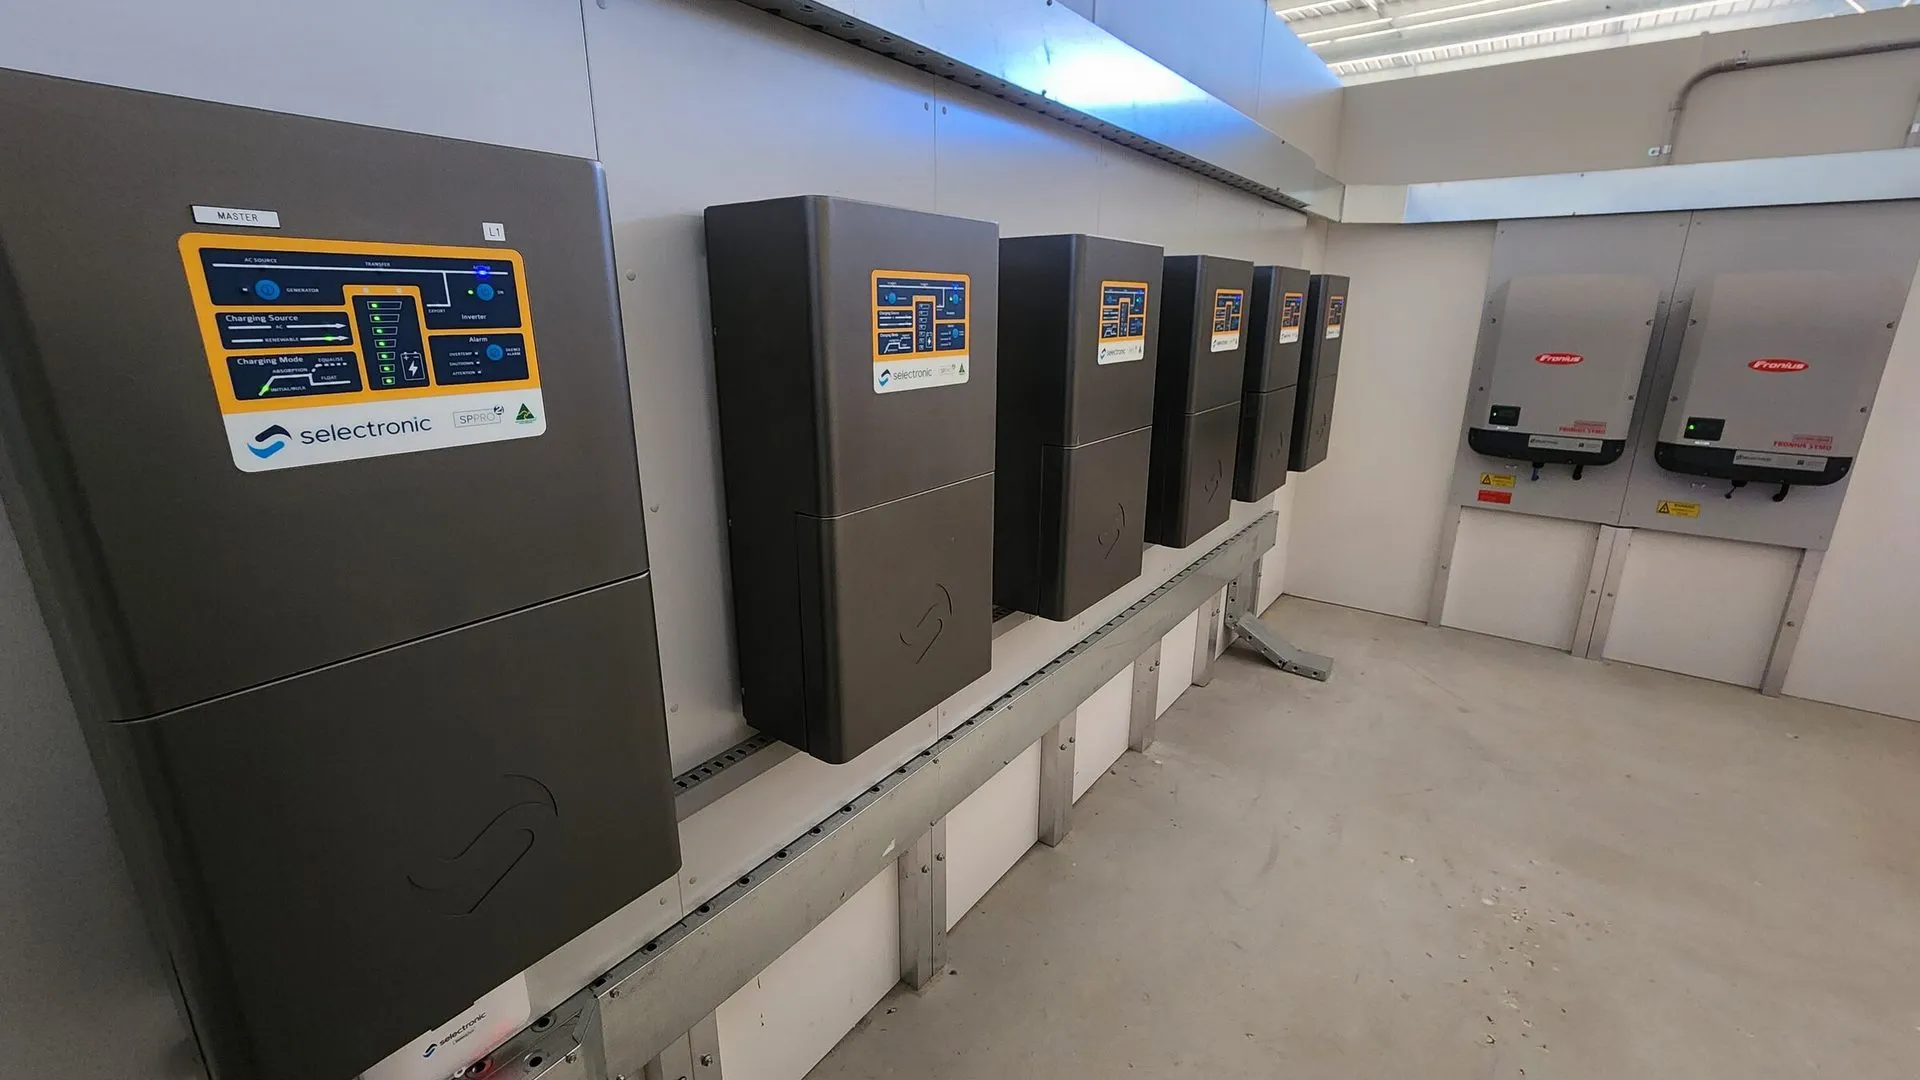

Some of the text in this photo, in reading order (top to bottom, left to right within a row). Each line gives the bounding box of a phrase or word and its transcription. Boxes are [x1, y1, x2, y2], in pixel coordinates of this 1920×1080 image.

[217, 211, 259, 222] MASTER
[488, 227, 501, 237] L1
[225, 314, 299, 323] Charging Source
[237, 356, 304, 366] Charging Mode
[1539, 354, 1581, 362] Fronius
[1755, 360, 1805, 370] Fronius
[892, 367, 933, 380] selectronic
[300, 416, 432, 445] selectronic
[440, 1012, 487, 1046] selectronic
